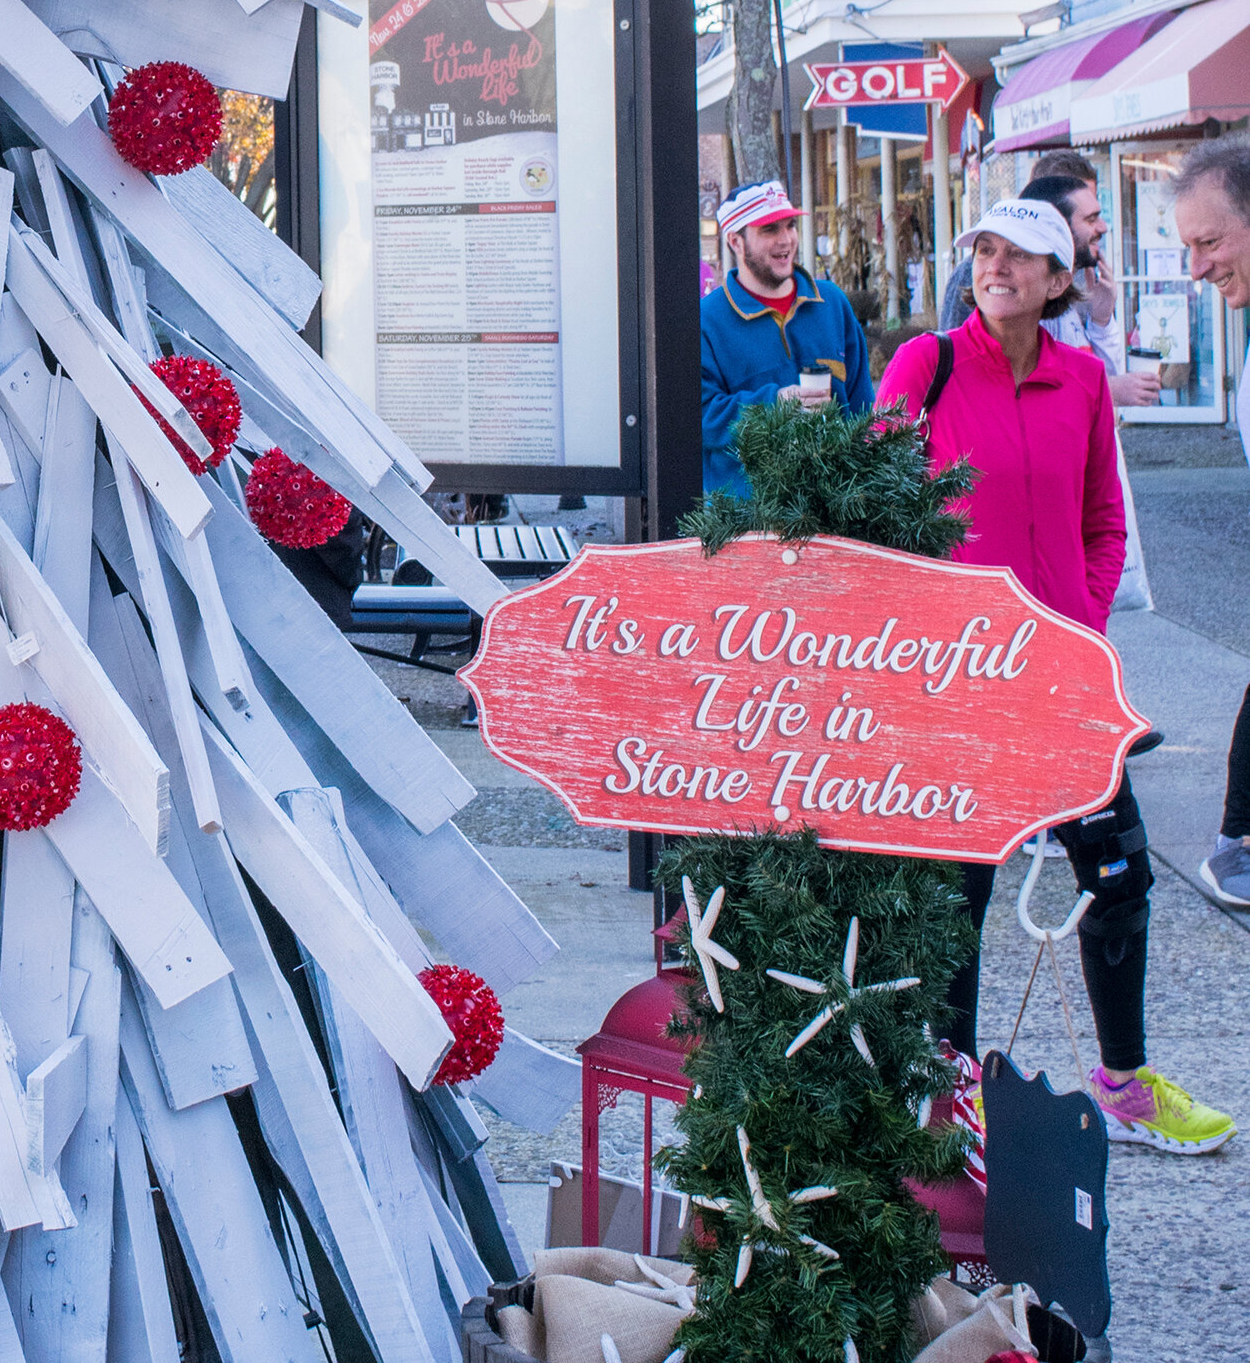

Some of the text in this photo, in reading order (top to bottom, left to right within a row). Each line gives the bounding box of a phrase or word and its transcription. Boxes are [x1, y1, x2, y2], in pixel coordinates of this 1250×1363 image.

[389, 11, 404, 30] 24
[422, 32, 477, 62] It's a
[433, 40, 542, 86] Wonderful
[825, 63, 948, 101] GOLF
[463, 109, 553, 126] in Stone Harbor
[376, 207, 403, 216] FRIDAY,
[404, 206, 445, 215] NOVEMBER
[379, 334, 419, 343] SATURDAY,
[419, 334, 459, 342] NOVEMBER
[563, 594, 1038, 695] It's a Wonderful
[692, 673, 881, 753] Life in
[603, 737, 978, 824] Stone Harbor
